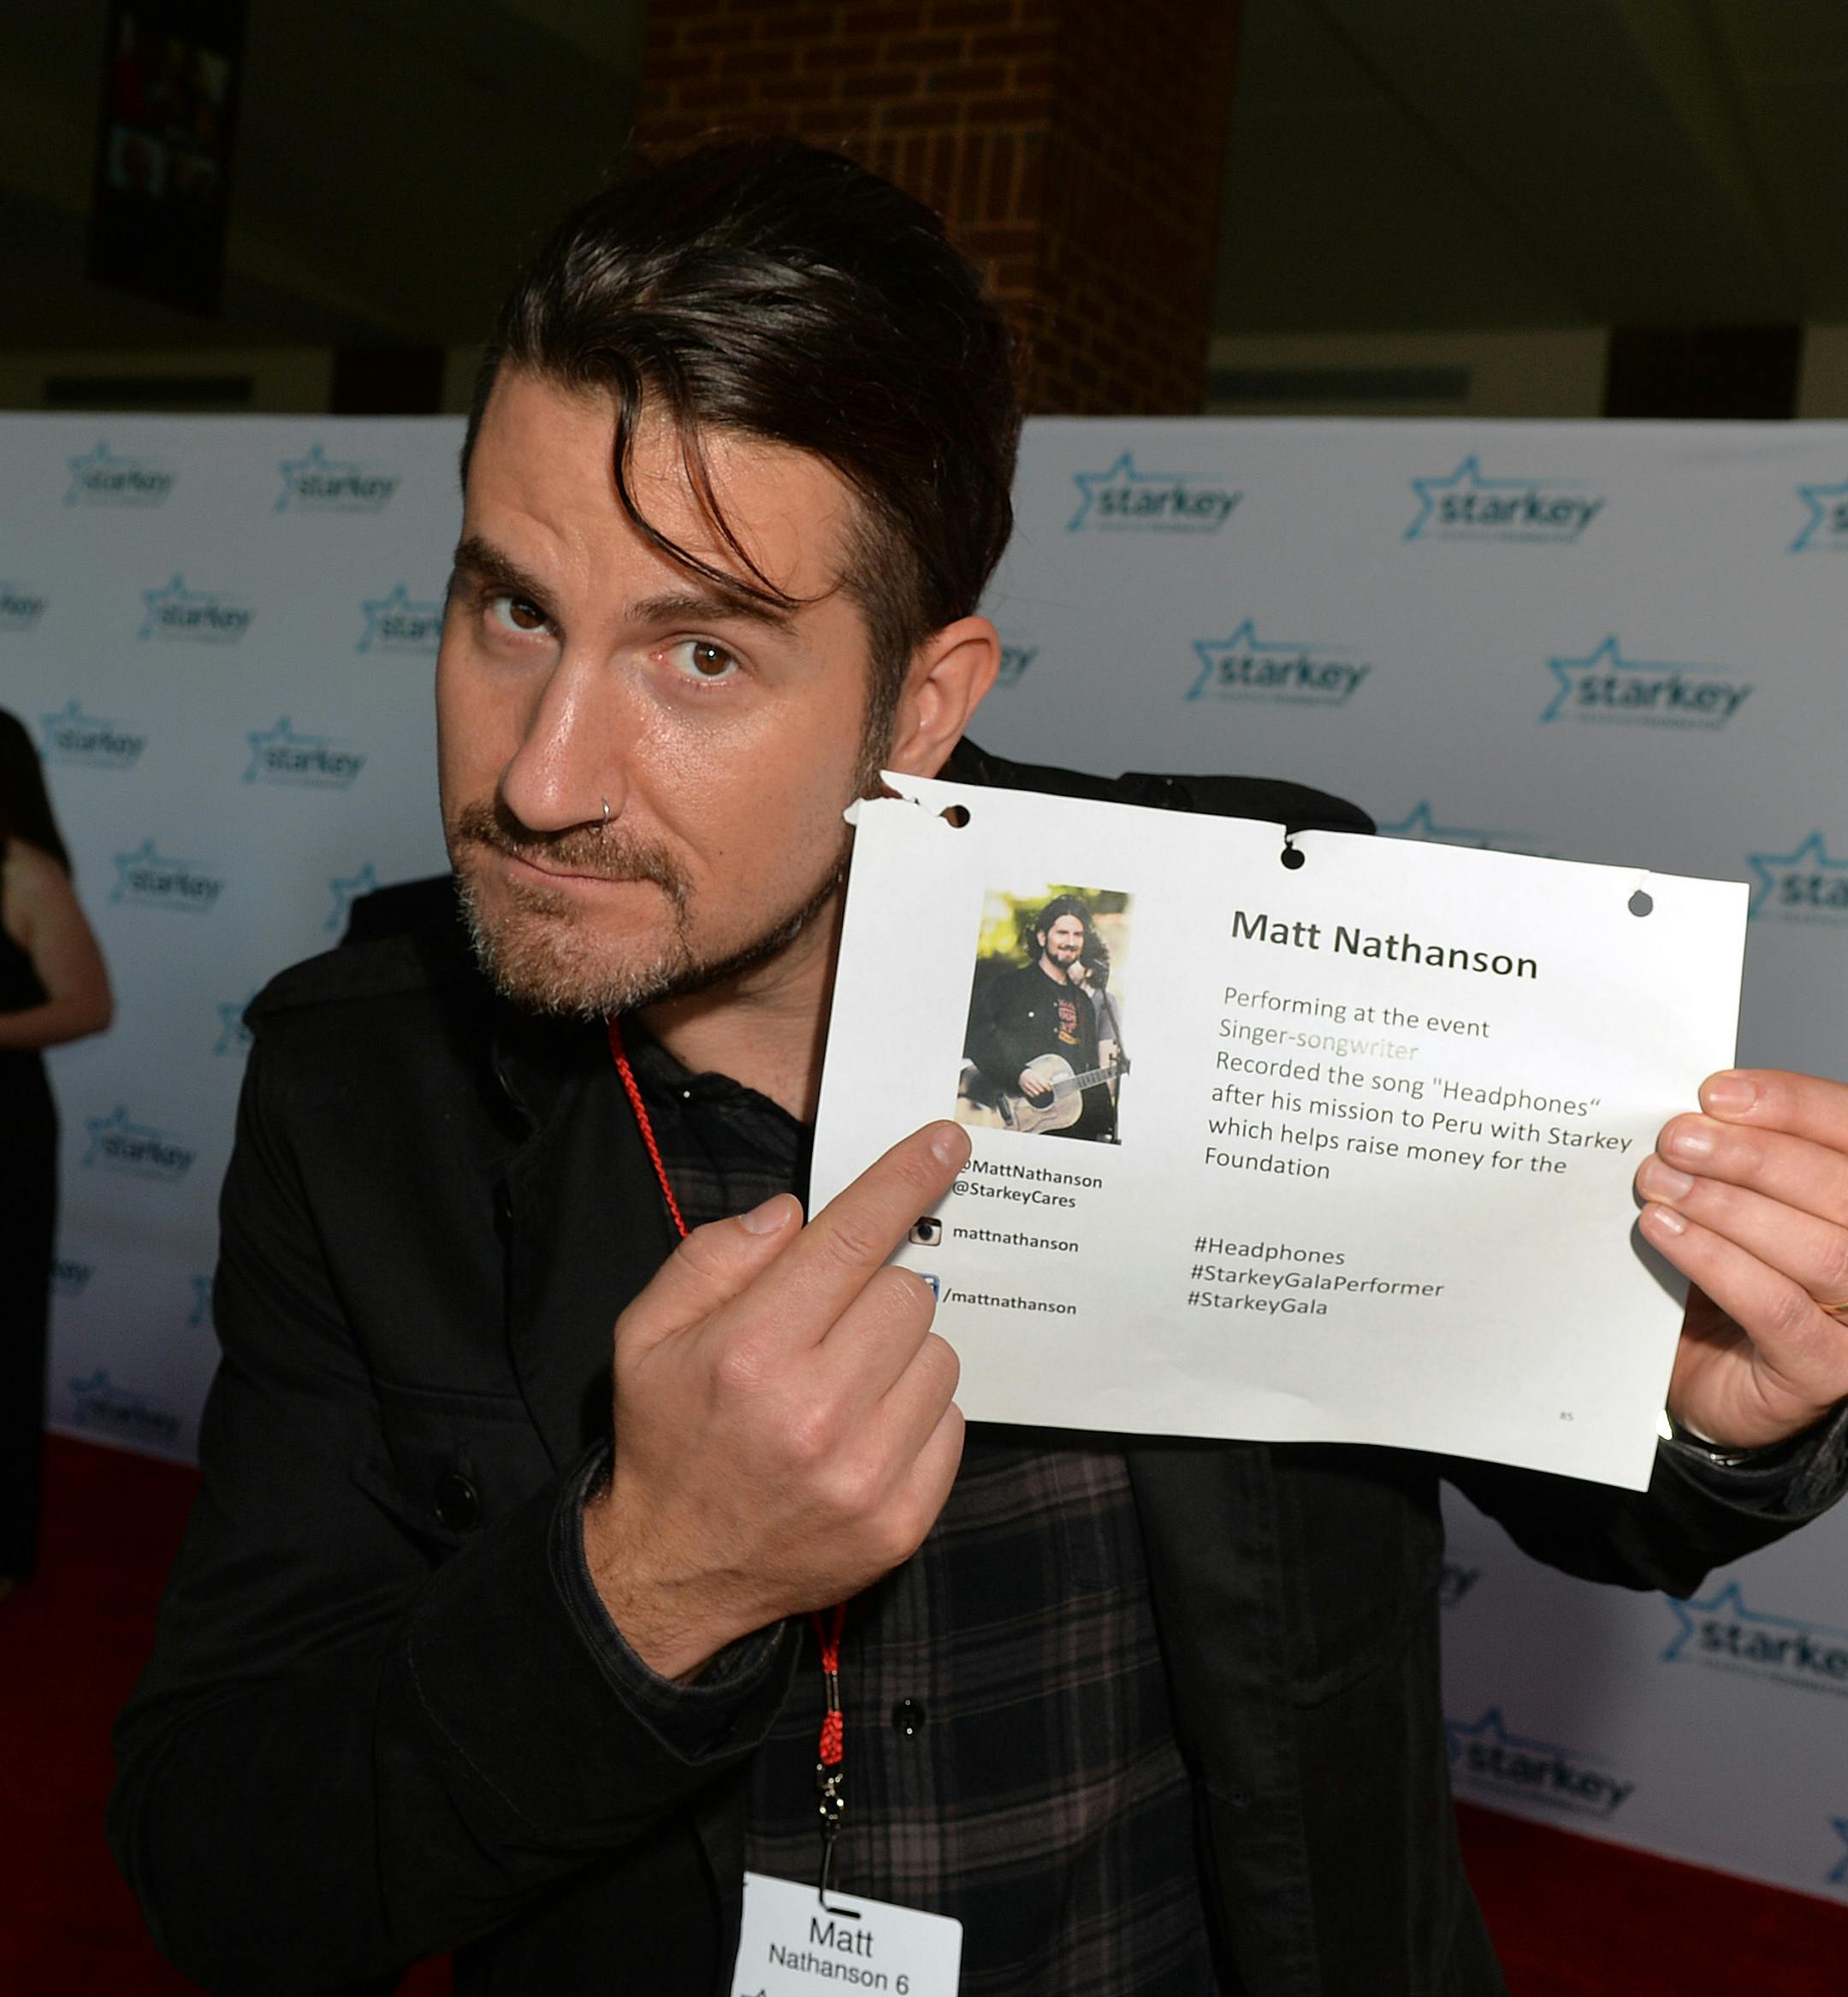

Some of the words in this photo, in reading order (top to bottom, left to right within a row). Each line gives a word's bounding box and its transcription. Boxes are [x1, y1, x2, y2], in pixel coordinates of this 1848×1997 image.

[1099, 481, 1247, 523] starkey
[1439, 490, 1606, 532] starkey
[1217, 652, 1371, 698] starkey
[1578, 669, 1756, 718] starkey
[1231, 910, 1322, 951] Matt
[1333, 925, 1538, 980] Nathanson
[1223, 986, 1348, 1024] Performing
[1353, 1005, 1377, 1024] at
[1382, 1006, 1419, 1029] the
[1426, 1016, 1490, 1039] event
[1218, 1018, 1419, 1061] Singer-songwriter
[1216, 1051, 1321, 1082] Recorded
[1327, 1064, 1365, 1088] the
[1371, 1075, 1425, 1100] song
[1211, 1083, 1265, 1107] after
[1270, 1088, 1302, 1113] his
[1309, 1098, 1394, 1125] mission
[1401, 1109, 1424, 1129] to
[1431, 1111, 1483, 1136] Peru
[1490, 1121, 1541, 1143] with
[1547, 1126, 1633, 1154] Starkey
[1205, 1147, 1330, 1180] Foundation
[1208, 1116, 1273, 1141] which
[1280, 1123, 1340, 1153] helps
[1346, 1135, 1400, 1158] raise
[1406, 1145, 1485, 1171] money
[1491, 1150, 1525, 1170] for
[1530, 1154, 1567, 1175] the
[951, 1180, 1076, 1208] @StarkeyCares
[952, 1226, 1079, 1253] mattnathanson
[1194, 1236, 1346, 1265] #Headphones
[942, 1287, 1077, 1315] /mattnathanson
[1190, 1263, 1445, 1297] #StarkeyGalaPerformer
[1187, 1290, 1328, 1316] #StarkeyGala
[1701, 1620, 1848, 1681] starke
[1467, 1741, 1636, 1809] starkey
[808, 1917, 874, 1958] Matt
[768, 1943, 889, 1990] Nathanson
[895, 1974, 910, 1996] 6
